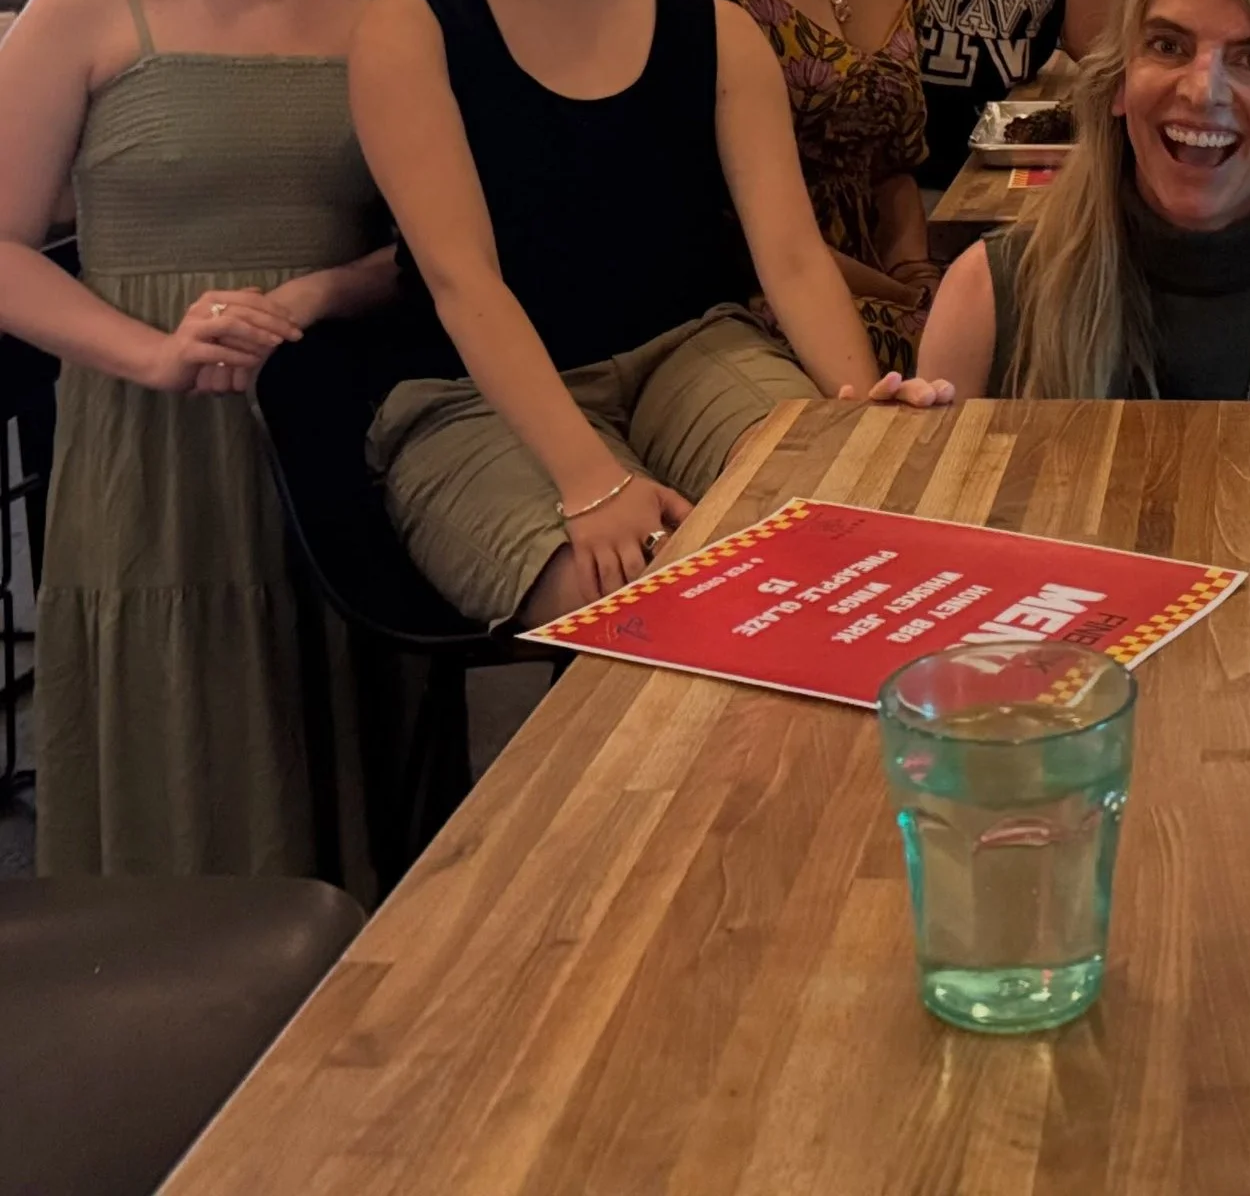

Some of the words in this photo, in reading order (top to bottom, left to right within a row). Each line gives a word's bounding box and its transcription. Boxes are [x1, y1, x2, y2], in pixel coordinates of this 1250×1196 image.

[757, 577, 799, 595] 15
[795, 550, 898, 603] PINEAPPLE
[884, 571, 964, 614] WHISKEY
[827, 582, 892, 614] WINGS
[928, 585, 993, 620] HONEY
[732, 601, 802, 637] GLAZE
[831, 613, 886, 644] JERK
[886, 618, 935, 644] BBQ
